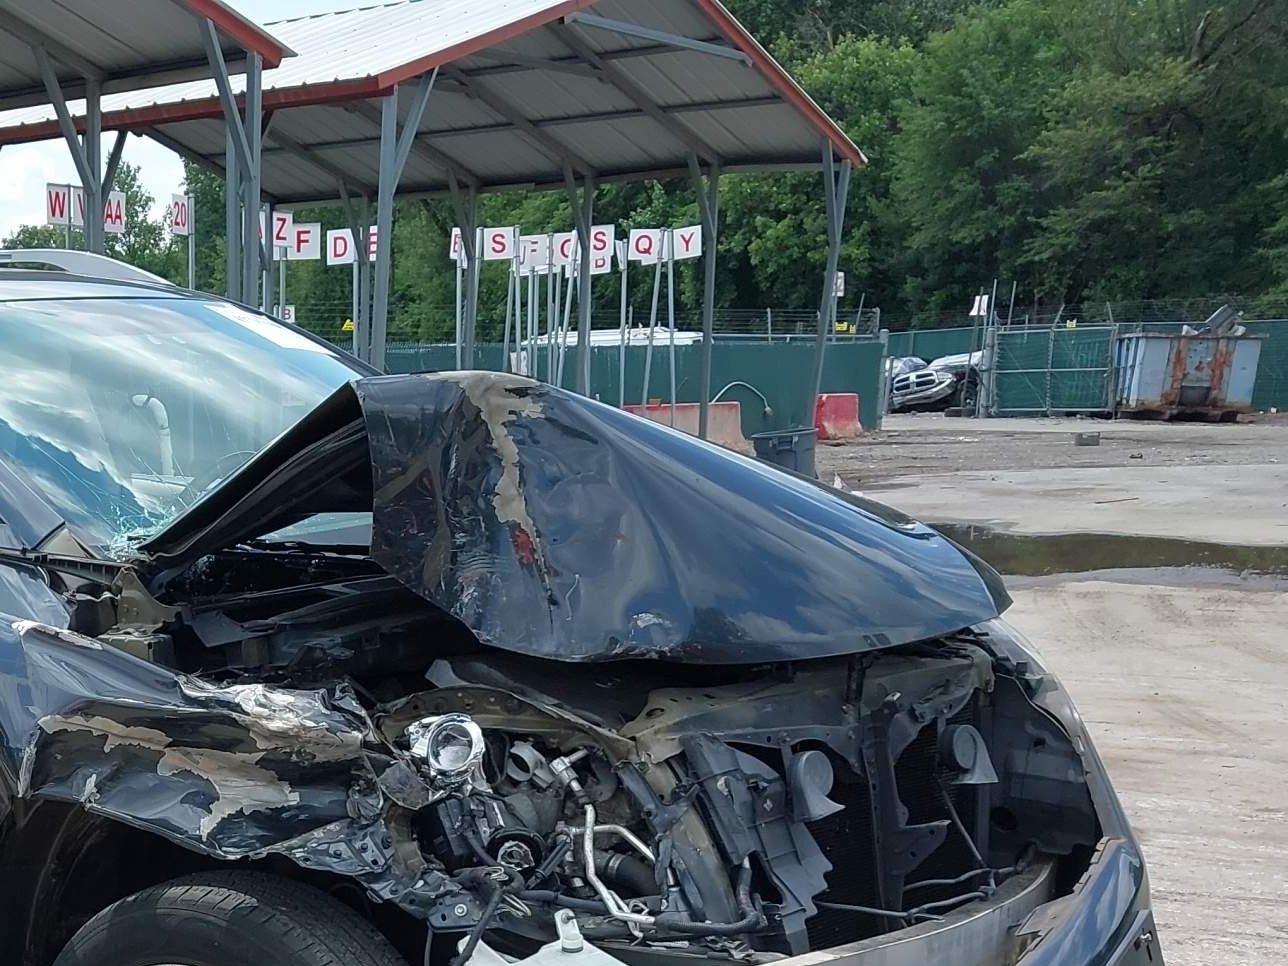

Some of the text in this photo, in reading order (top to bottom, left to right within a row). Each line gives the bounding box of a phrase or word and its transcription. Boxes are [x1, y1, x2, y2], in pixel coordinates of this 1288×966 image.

[48, 191, 66, 218] W
[173, 201, 187, 228] 20
[275, 217, 287, 241] Z
[296, 230, 311, 253] F
[333, 236, 348, 258] D
[491, 233, 506, 254] S
[593, 231, 607, 251] S
[635, 234, 653, 255] Q
[680, 232, 695, 252] Y
